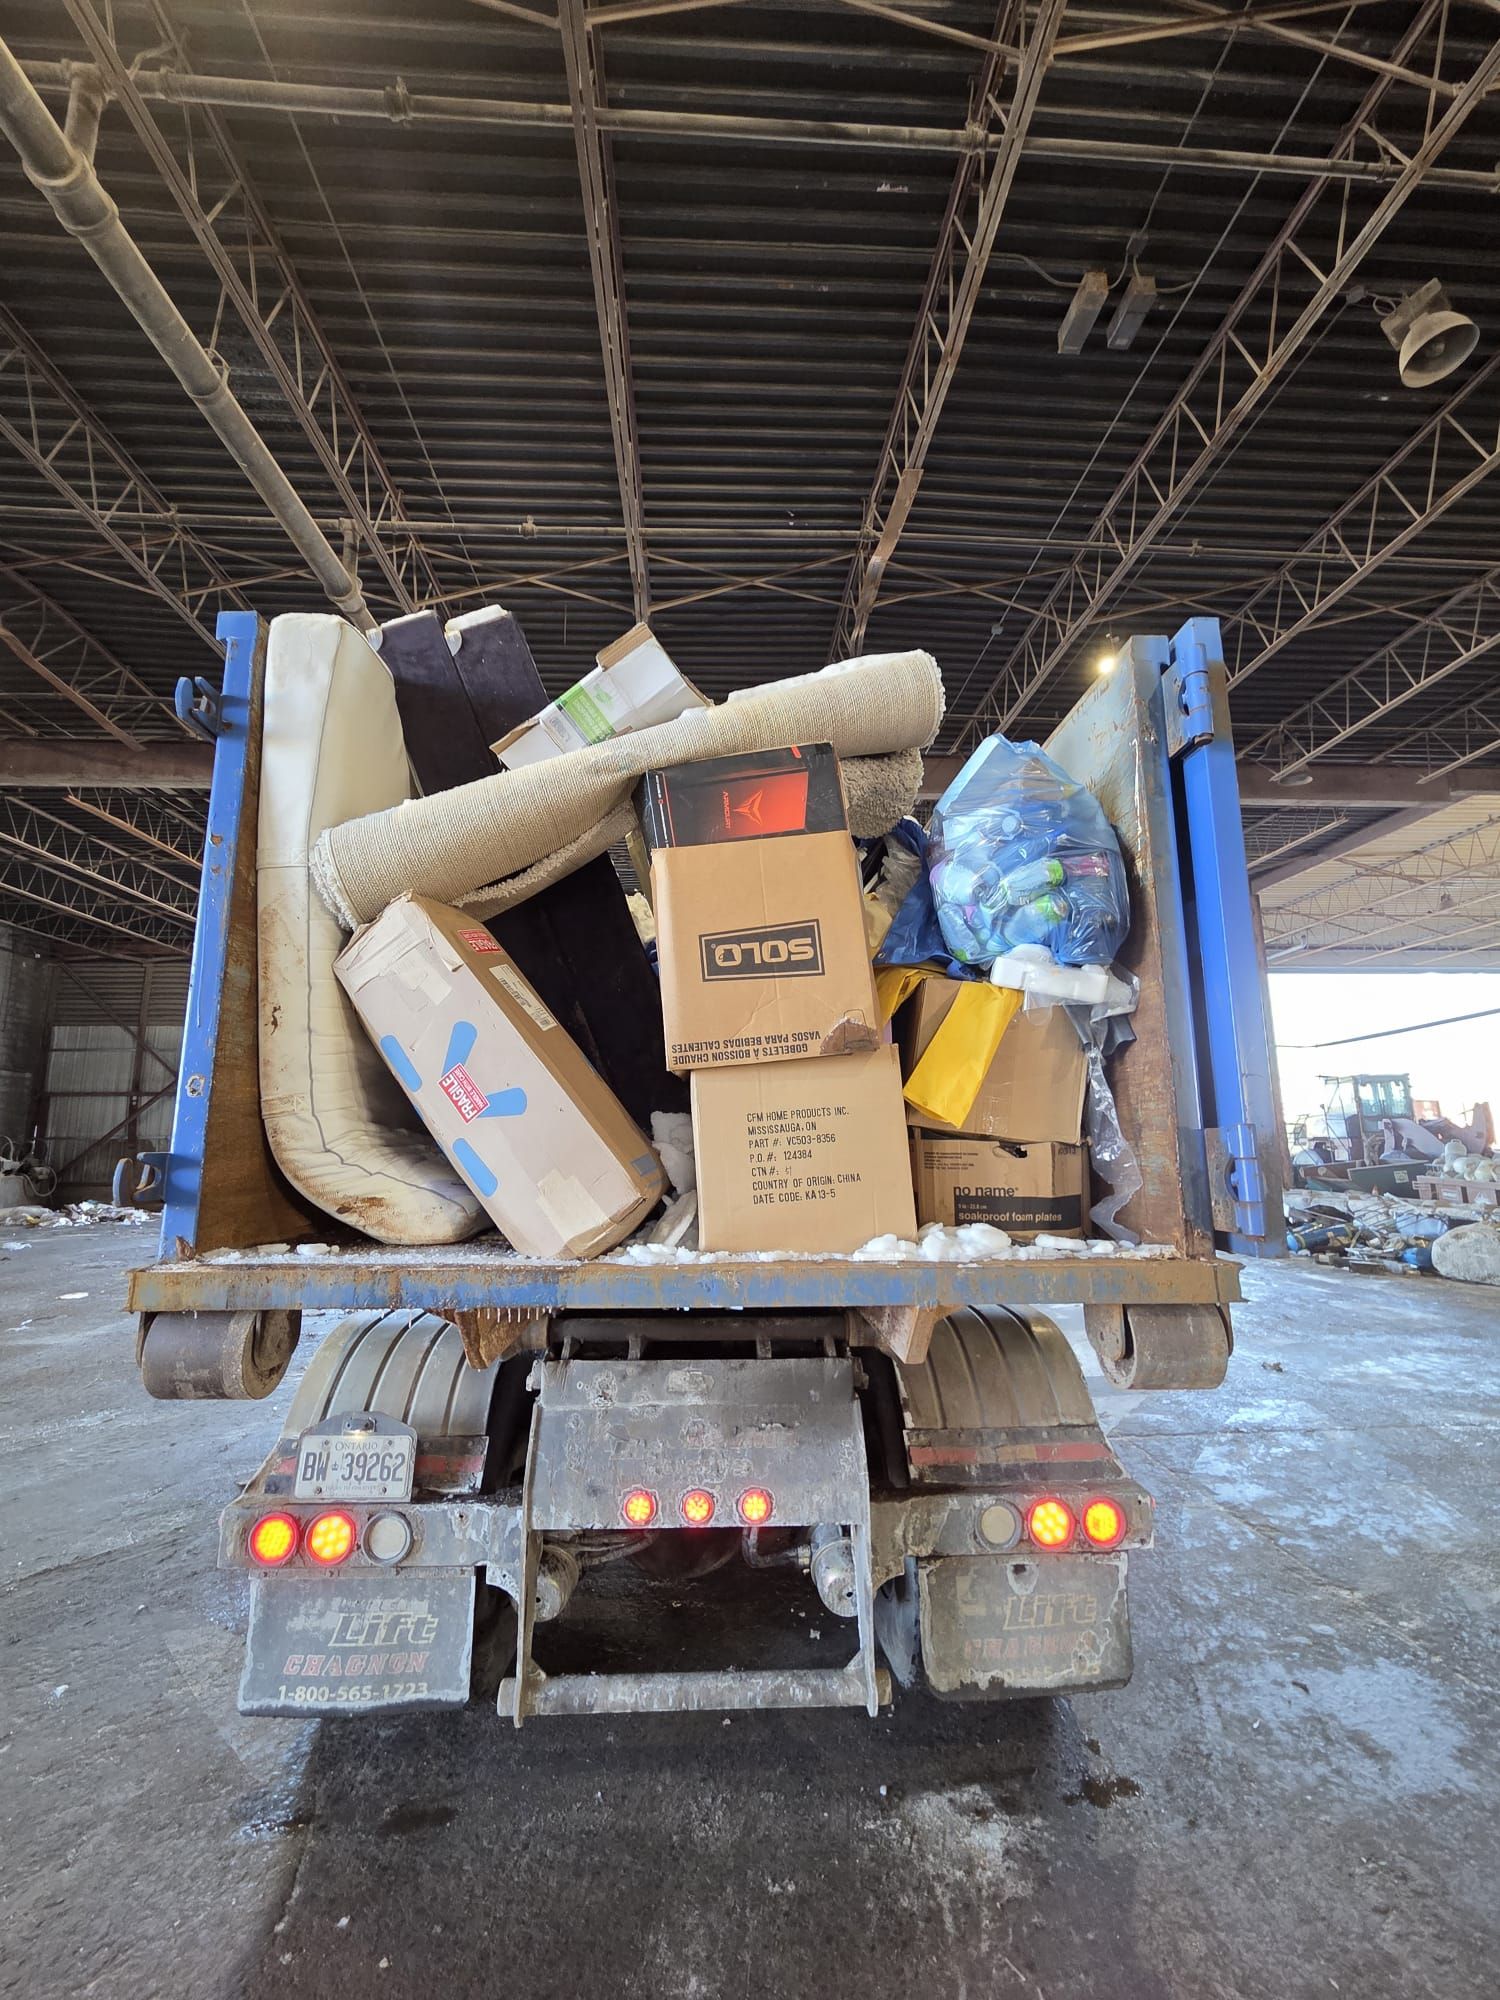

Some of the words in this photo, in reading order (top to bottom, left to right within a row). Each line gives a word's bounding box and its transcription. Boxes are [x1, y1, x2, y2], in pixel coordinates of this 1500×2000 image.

[715, 937, 814, 967] SOLO
[722, 1036, 762, 1050] BEBIDAS
[764, 1033, 788, 1046] PARA
[791, 1031, 821, 1043] VASOS
[671, 1040, 720, 1054] CALIENTES
[752, 1047, 760, 1060] À
[761, 1043, 808, 1056] GOBELETS
[672, 1053, 709, 1066] CHAUDE
[711, 1049, 751, 1062] BOISSON
[441, 1074, 477, 1119] FRAGILE
[746, 1112, 763, 1122] CFM
[766, 1110, 788, 1121] HOME
[790, 1107, 831, 1119] PRODUCTS
[834, 1106, 849, 1115] INC.
[805, 1121, 817, 1131] ON
[748, 1138, 769, 1149] PART
[786, 1133, 836, 1146] VC503-8356
[783, 1149, 813, 1160] 124384
[751, 1167, 767, 1177] CTN
[752, 1178, 788, 1191] COUNTRY
[793, 1178, 803, 1188] OF
[806, 1175, 835, 1187] ORIGIN:
[837, 1173, 861, 1183] CHINA
[753, 1193, 775, 1205] DATE
[778, 1191, 803, 1203] CODE:
[954, 1186, 971, 1197] no
[975, 1186, 1015, 1198] name
[959, 1211, 1009, 1222] soakproof
[1011, 1212, 1033, 1222] foam
[1035, 1212, 1062, 1223] plates
[335, 1441, 378, 1451] ONTARIO
[302, 1451, 330, 1482] BW
[341, 1451, 406, 1482] 39262
[328, 1613, 439, 1647] Lift
[282, 1651, 430, 1677] CHAGNON
[278, 1682, 428, 1702] 1-800-565-1723
